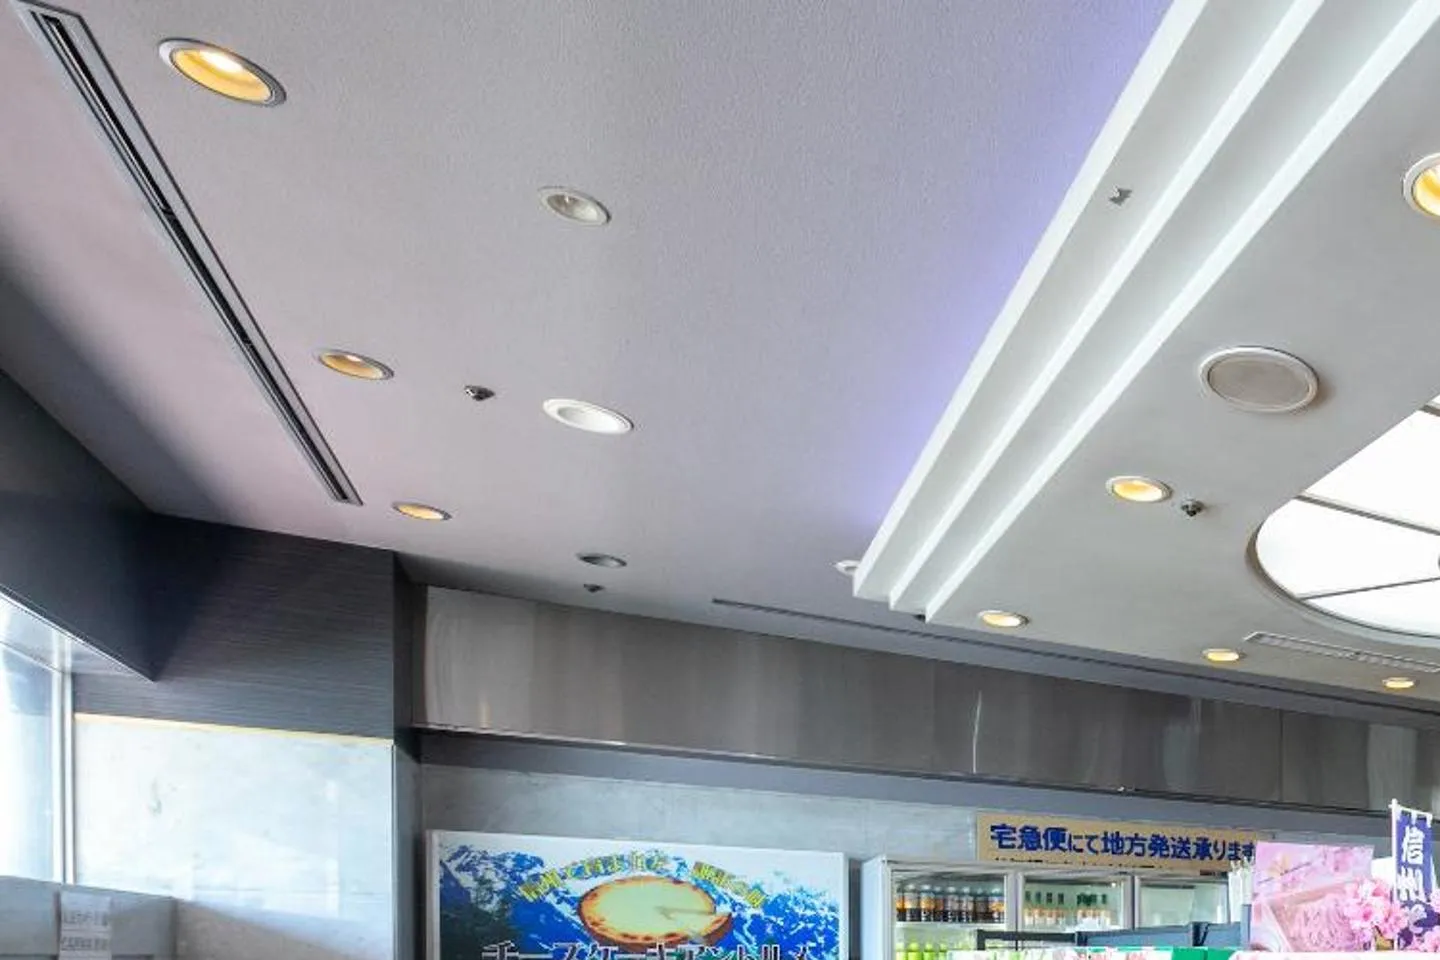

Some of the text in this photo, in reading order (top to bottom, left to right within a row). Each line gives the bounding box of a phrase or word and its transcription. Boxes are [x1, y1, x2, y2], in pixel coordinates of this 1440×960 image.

[989, 823, 1256, 862] 宅急便にて地方発送承ります
